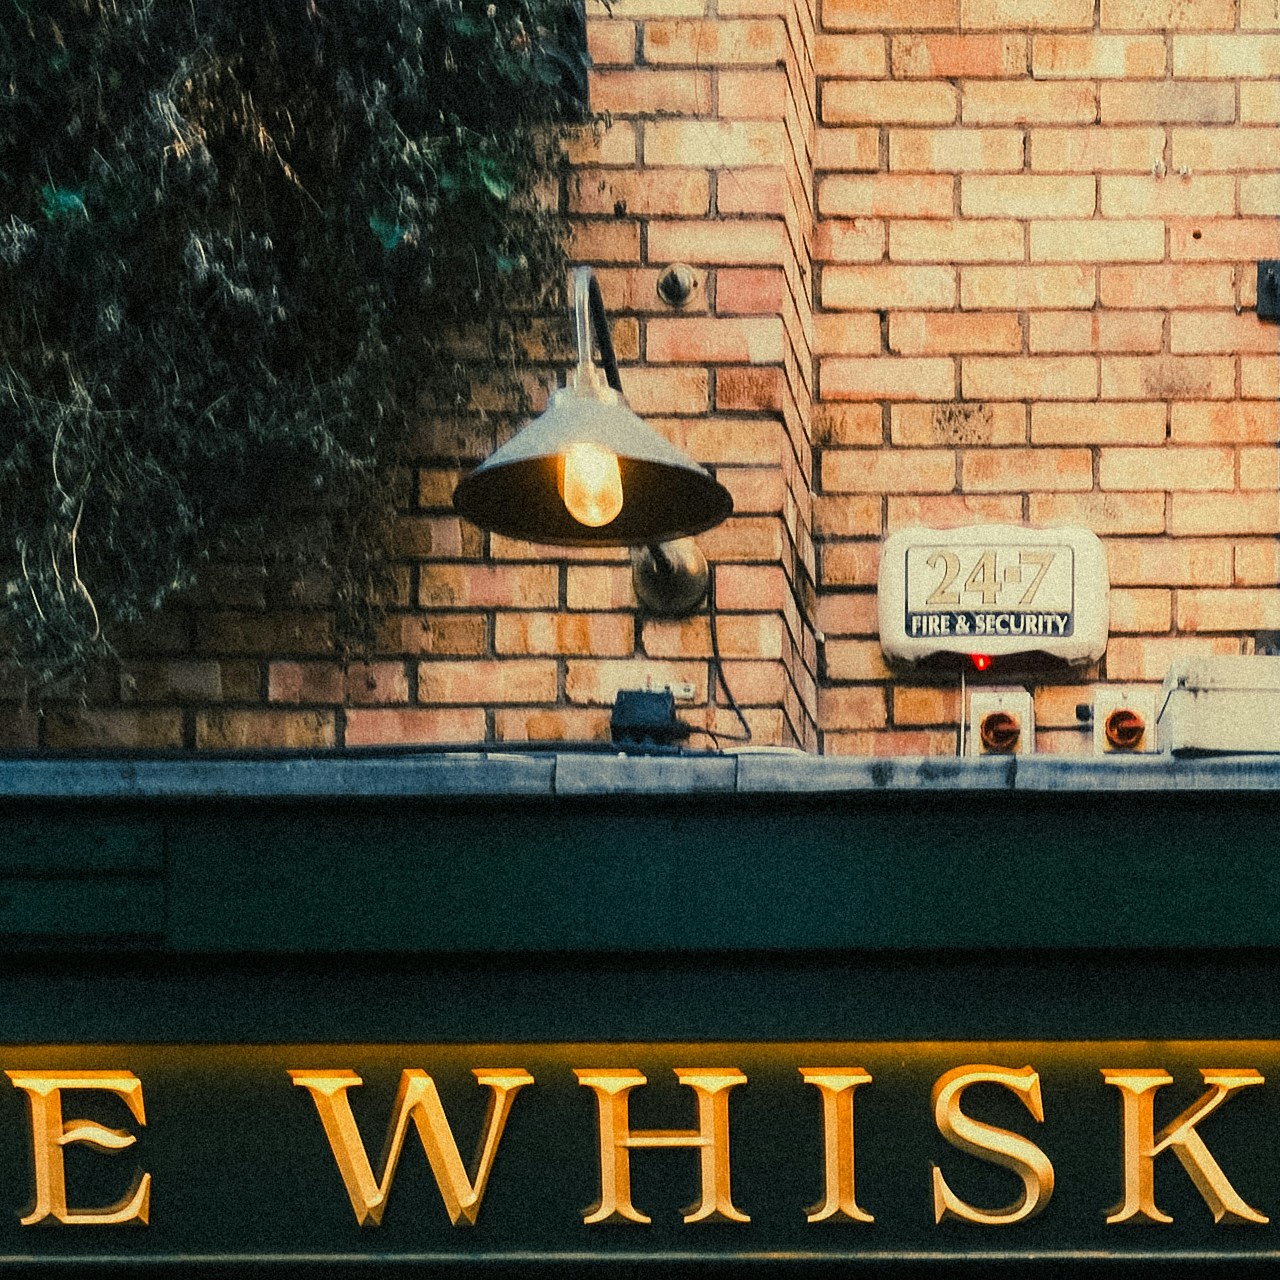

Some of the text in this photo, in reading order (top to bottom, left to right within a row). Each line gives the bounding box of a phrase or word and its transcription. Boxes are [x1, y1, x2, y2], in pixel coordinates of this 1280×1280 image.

[911, 613, 1069, 636] FIRE & SECURITY
[4, 1068, 151, 1226] E
